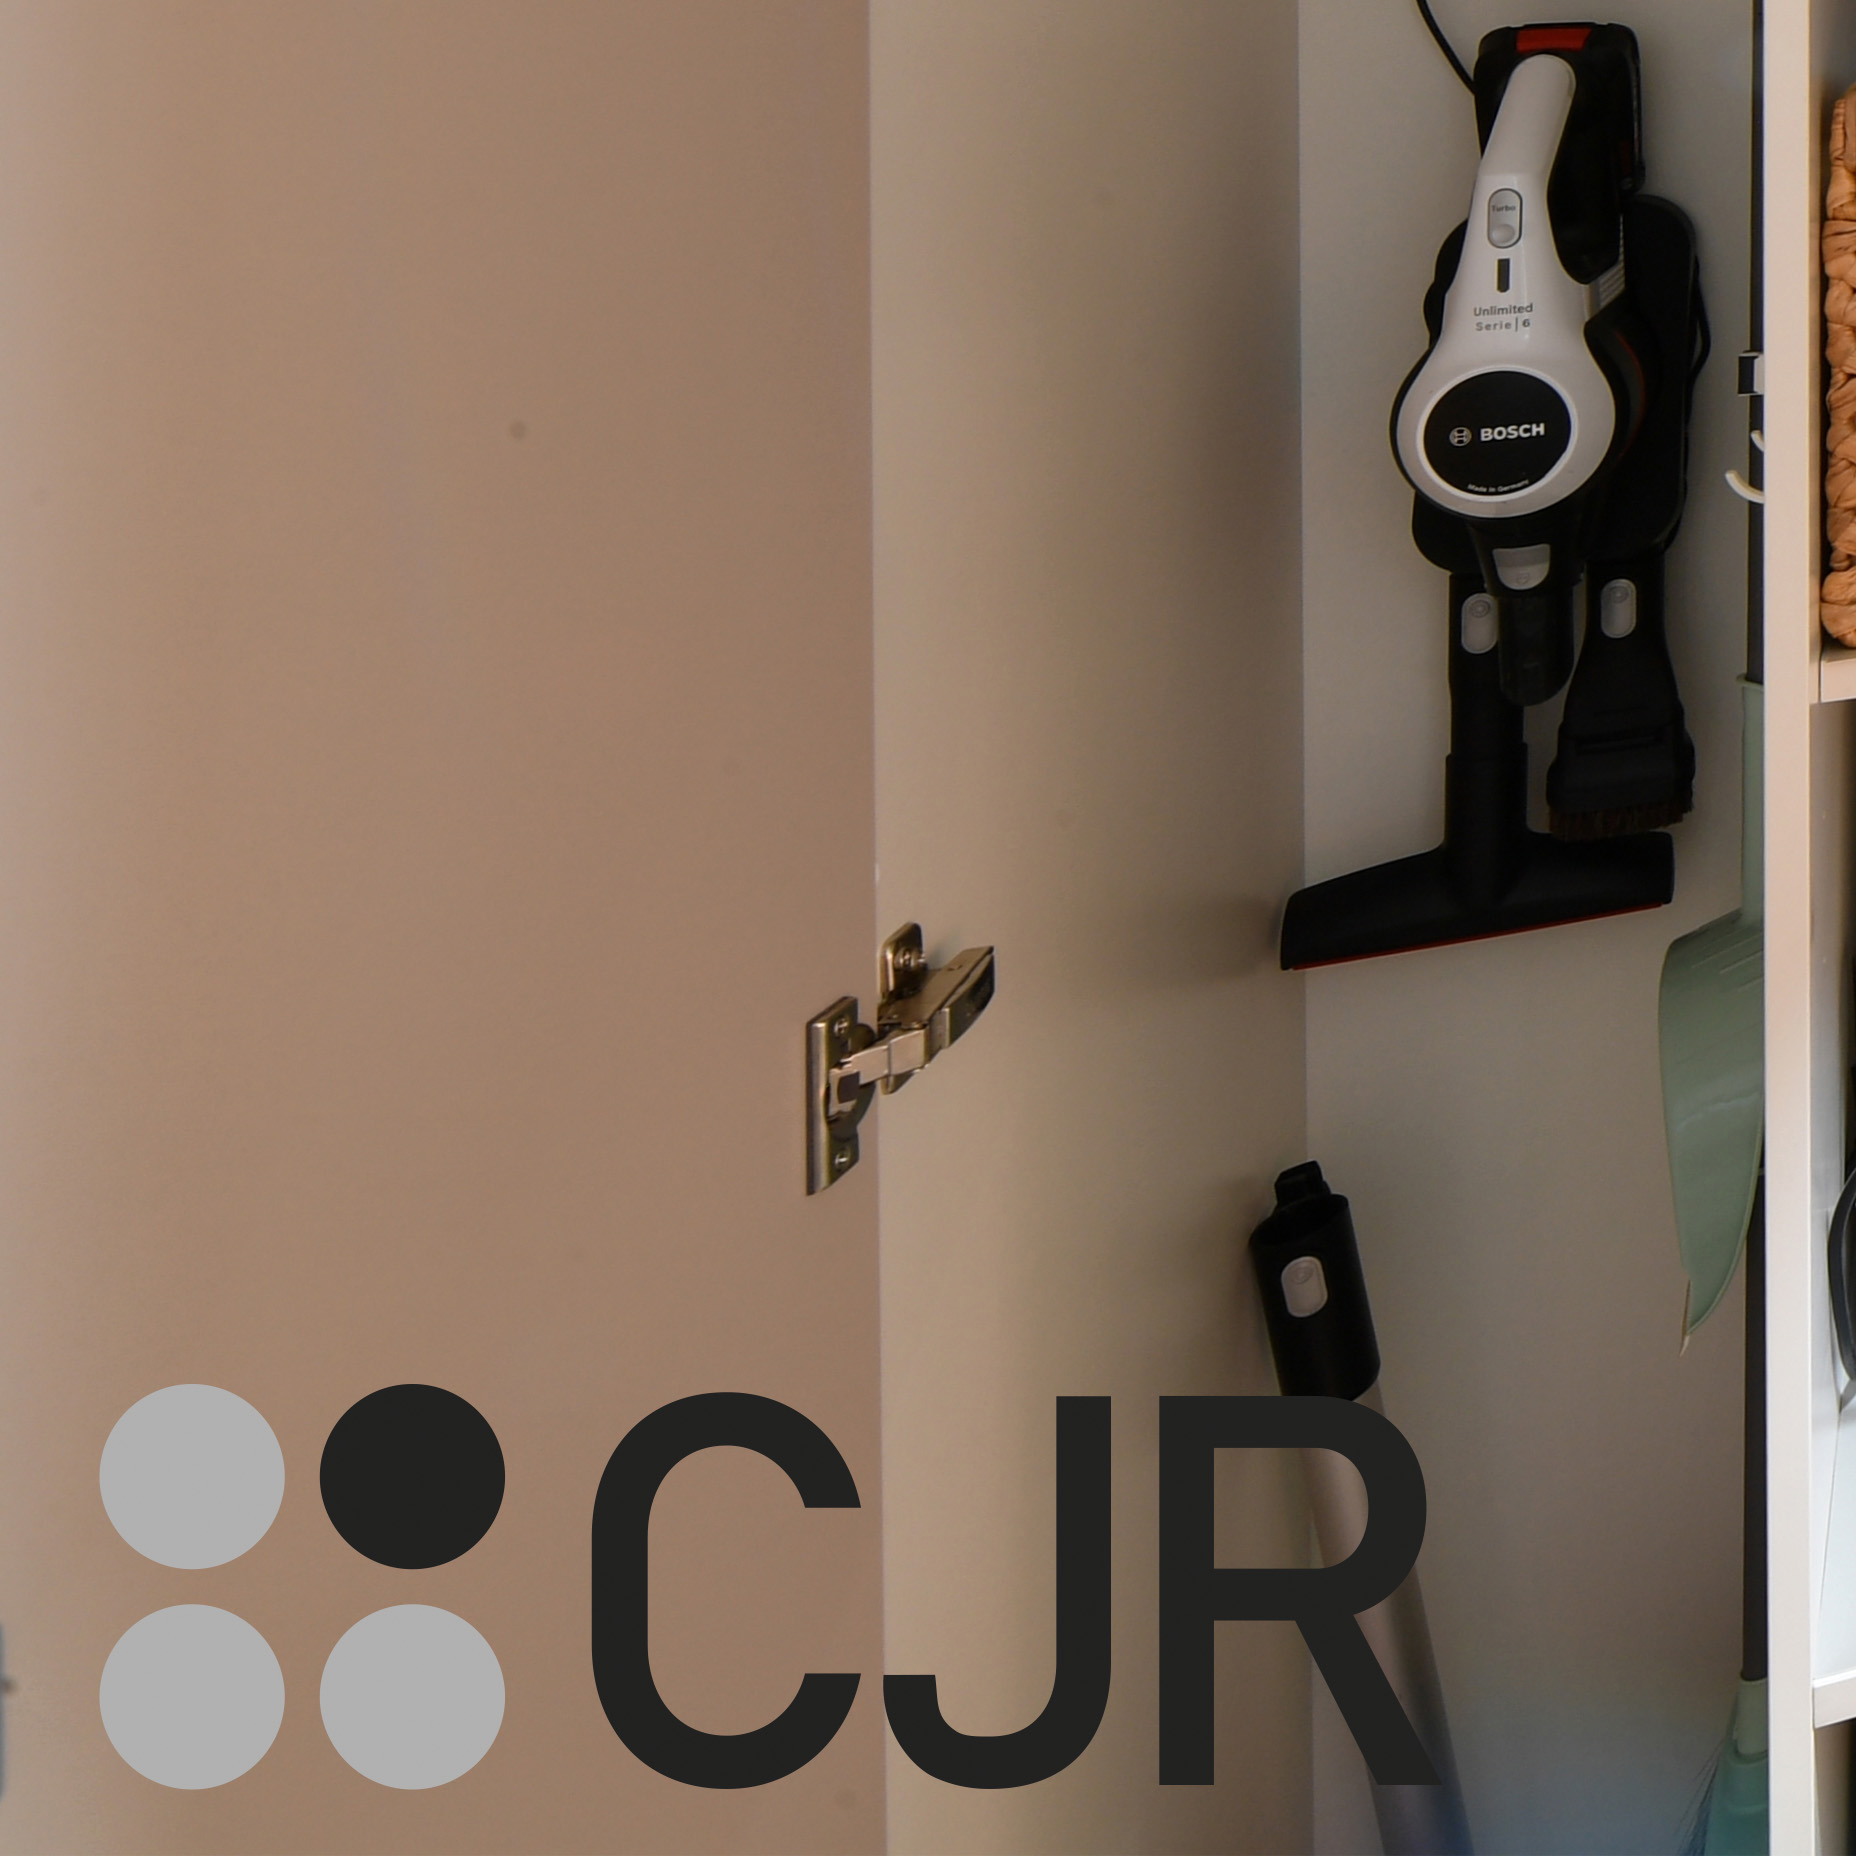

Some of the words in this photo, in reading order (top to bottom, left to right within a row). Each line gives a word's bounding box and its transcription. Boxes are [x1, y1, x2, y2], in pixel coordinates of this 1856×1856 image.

[1491, 204, 1517, 213] Turbo
[1474, 302, 1534, 317] Unlimited
[1475, 320, 1513, 332] Serie
[1480, 422, 1546, 442] BOSCH
[1467, 483, 1488, 493] Made
[1488, 485, 1497, 493] in
[1497, 479, 1530, 493] Germany
